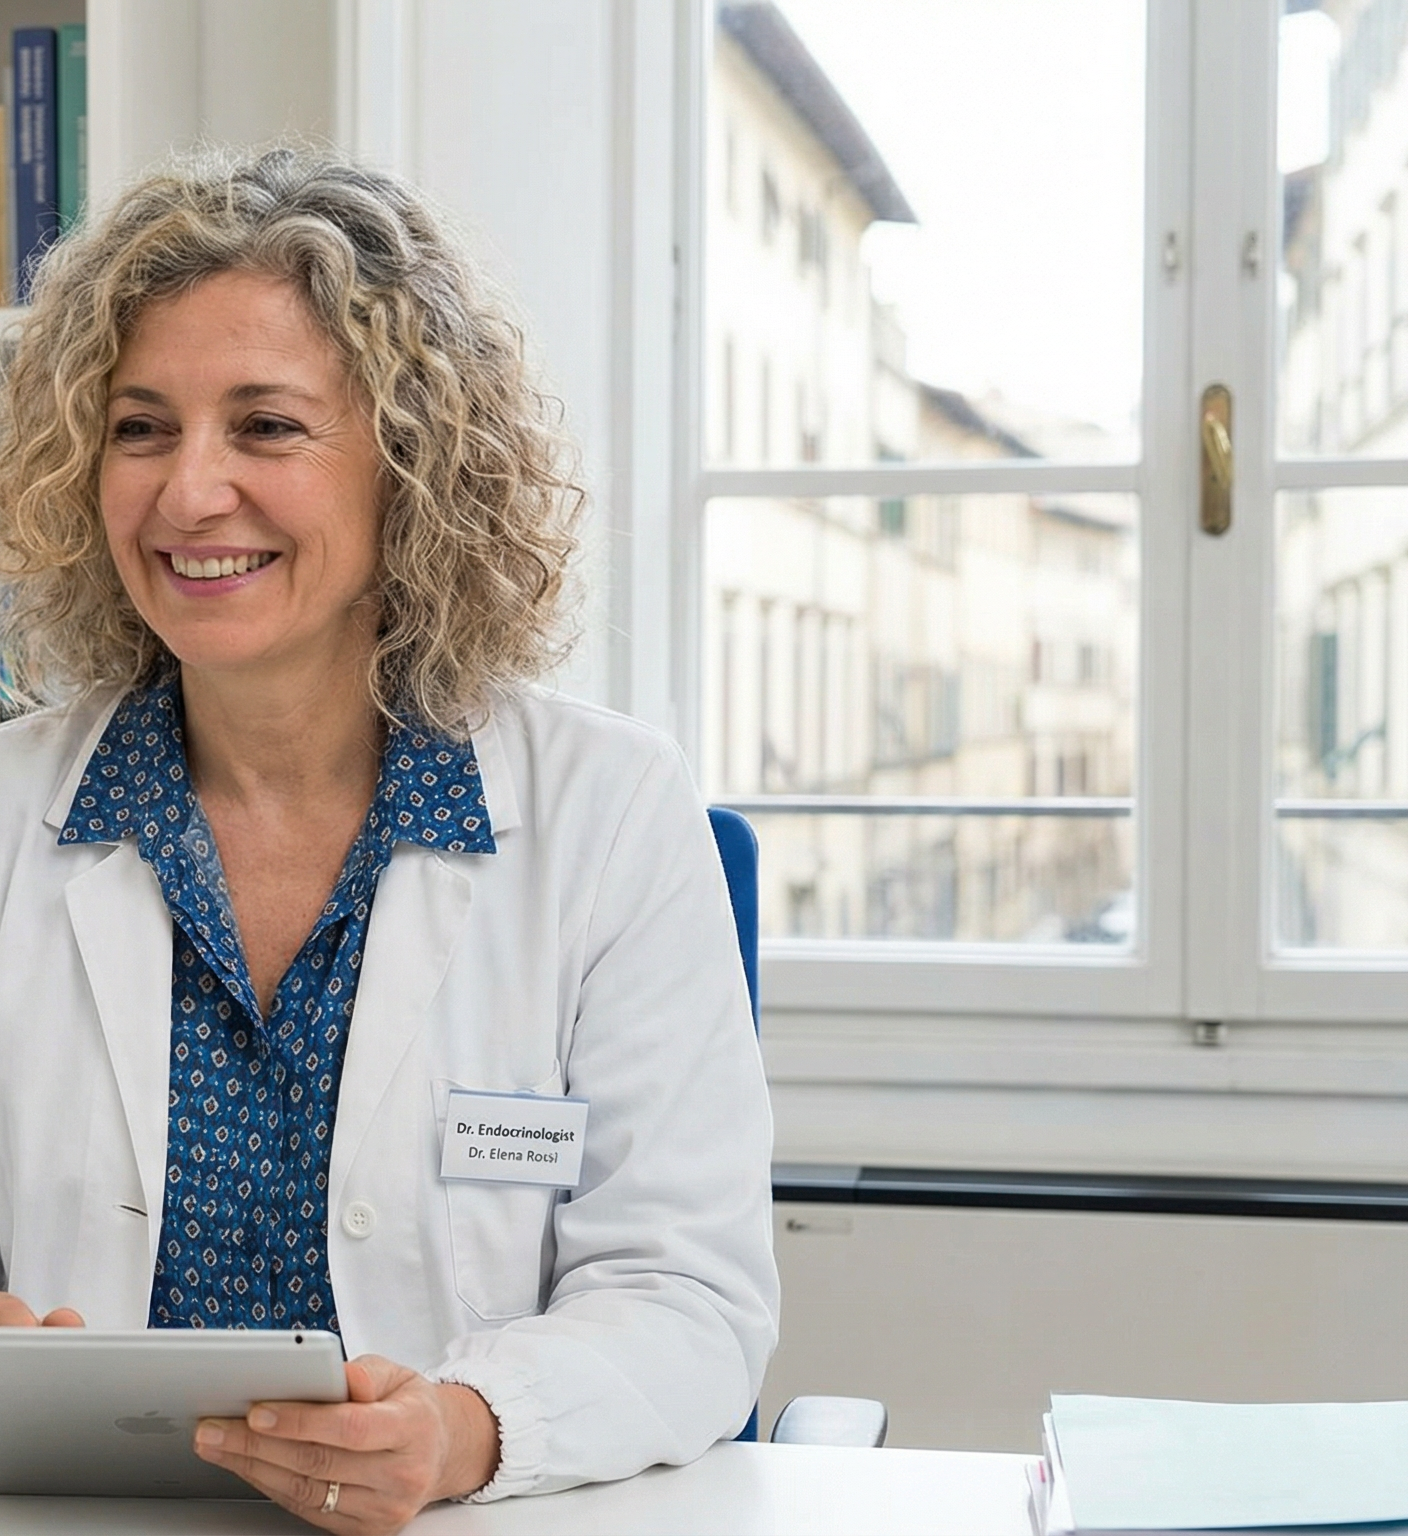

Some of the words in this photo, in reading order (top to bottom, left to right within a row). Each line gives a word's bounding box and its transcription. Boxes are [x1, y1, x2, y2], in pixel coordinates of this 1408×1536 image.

[456, 1122, 474, 1135] Dr.
[478, 1123, 575, 1143] Endocrinologist
[468, 1146, 485, 1159] Dr.
[489, 1148, 523, 1161] Elena
